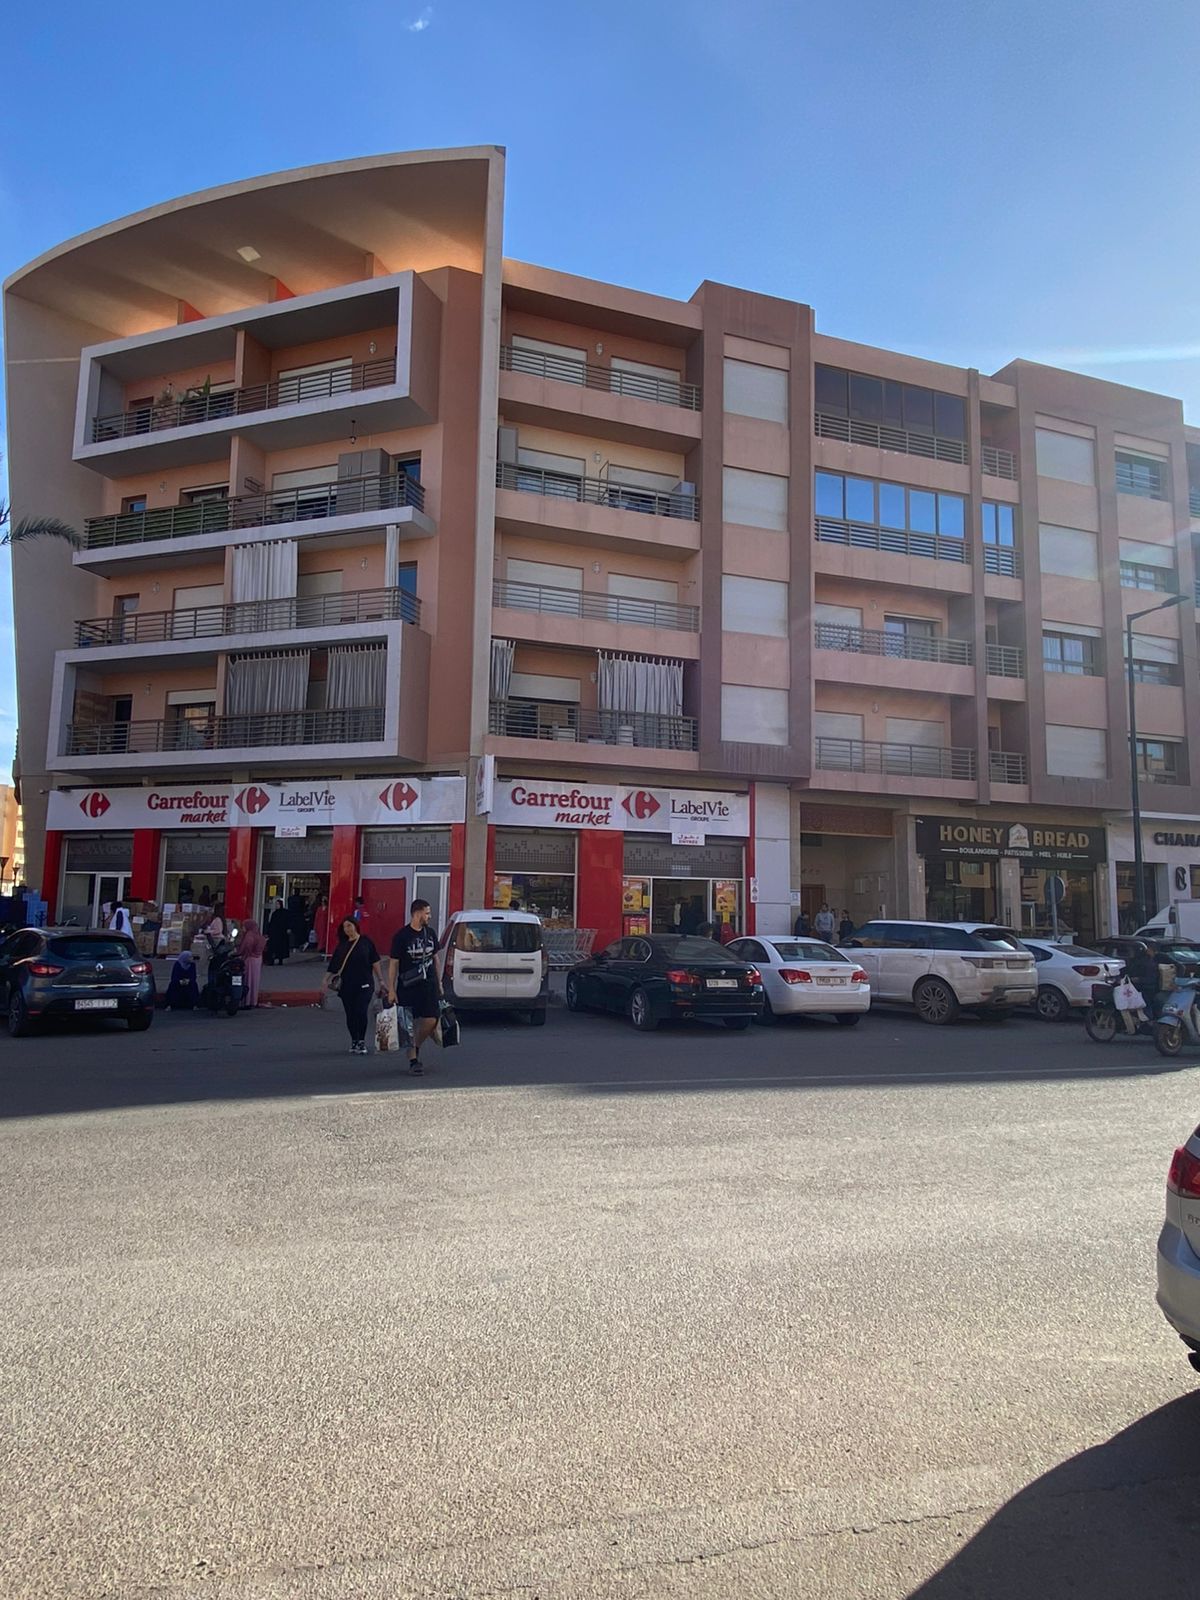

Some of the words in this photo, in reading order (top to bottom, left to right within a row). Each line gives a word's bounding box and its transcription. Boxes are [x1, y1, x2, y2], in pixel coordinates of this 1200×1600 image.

[147, 790, 229, 810] Carrefour
[279, 789, 336, 807] LabelVie
[511, 786, 613, 810] Carrefour
[180, 809, 228, 824] market
[671, 799, 729, 817] LabelVie
[554, 810, 612, 826] market
[939, 824, 1004, 844] HONEY
[1032, 830, 1090, 849] BREAD
